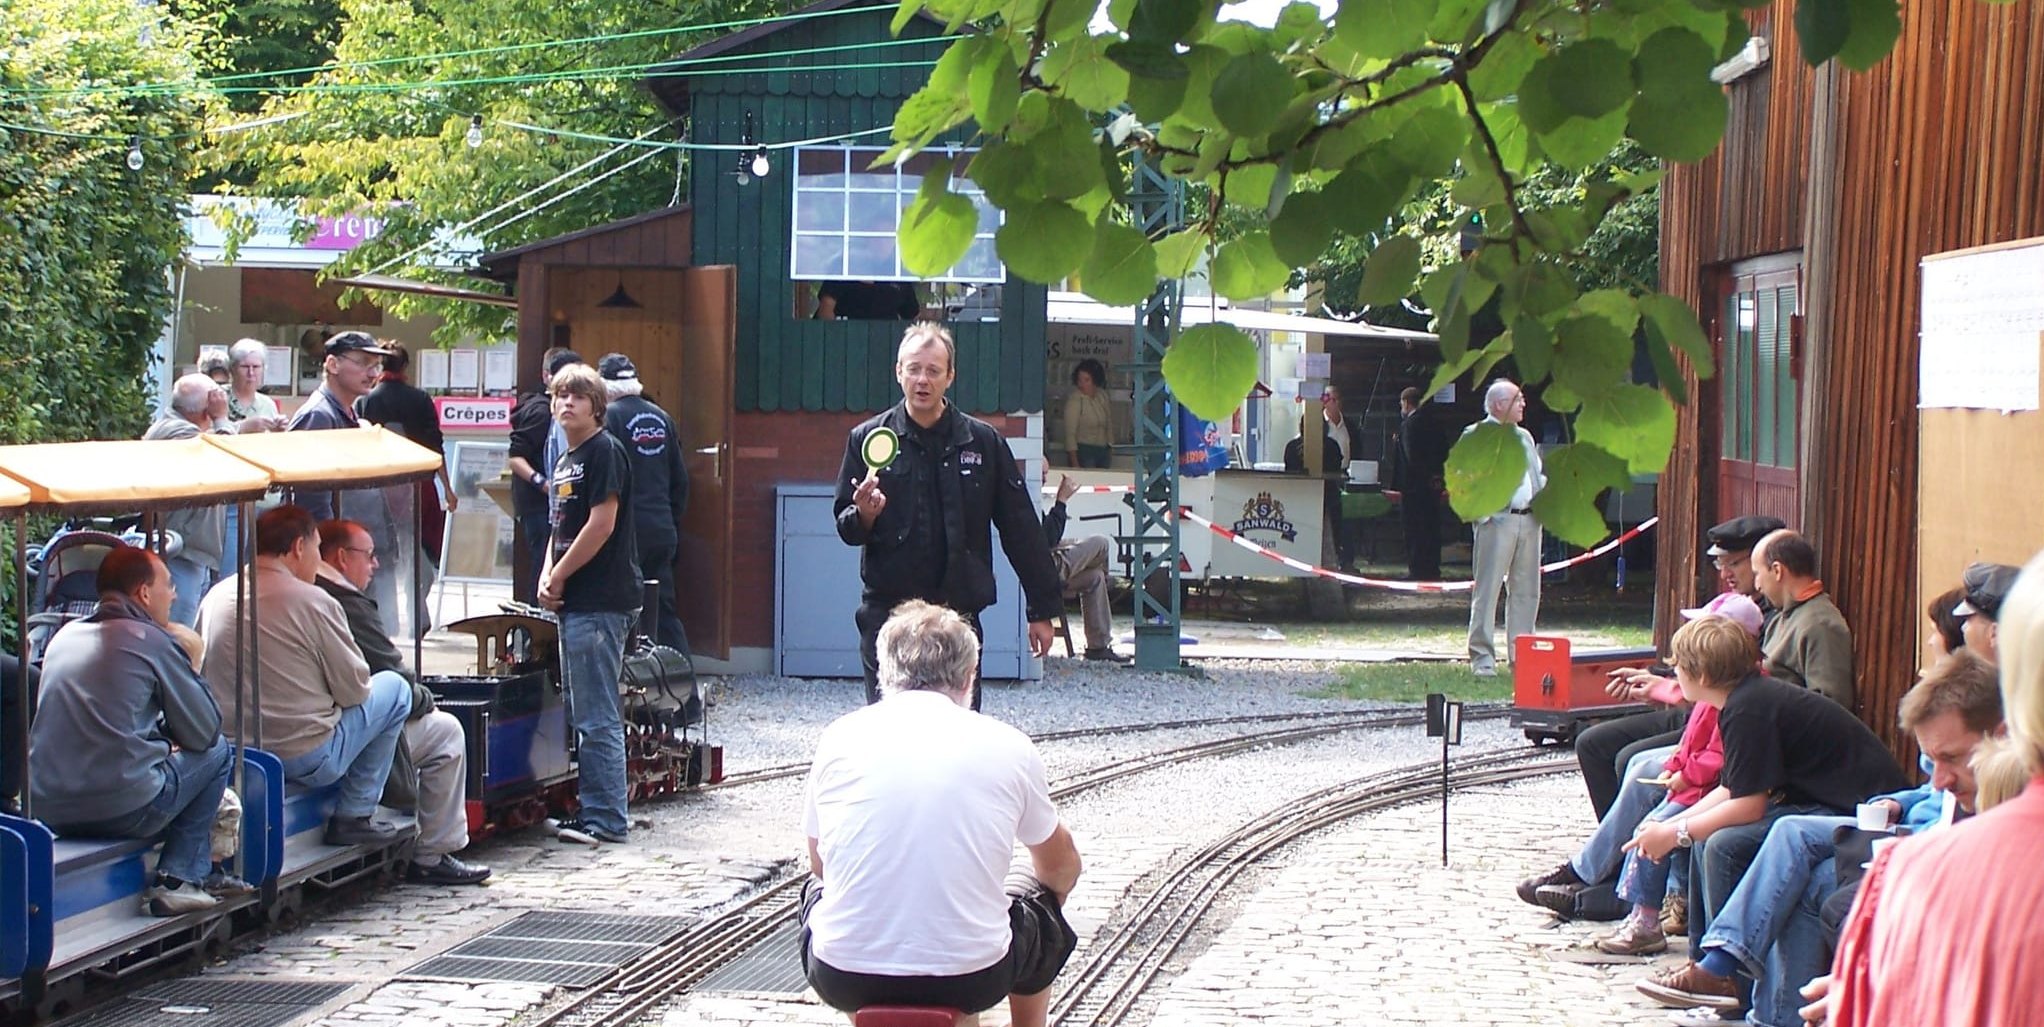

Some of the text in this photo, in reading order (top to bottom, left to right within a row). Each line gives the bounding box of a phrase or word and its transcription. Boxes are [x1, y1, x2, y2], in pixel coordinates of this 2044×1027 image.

[444, 406, 507, 423] Crêpes
[1260, 504, 1268, 516] S
[1236, 518, 1291, 532] SANWALD
